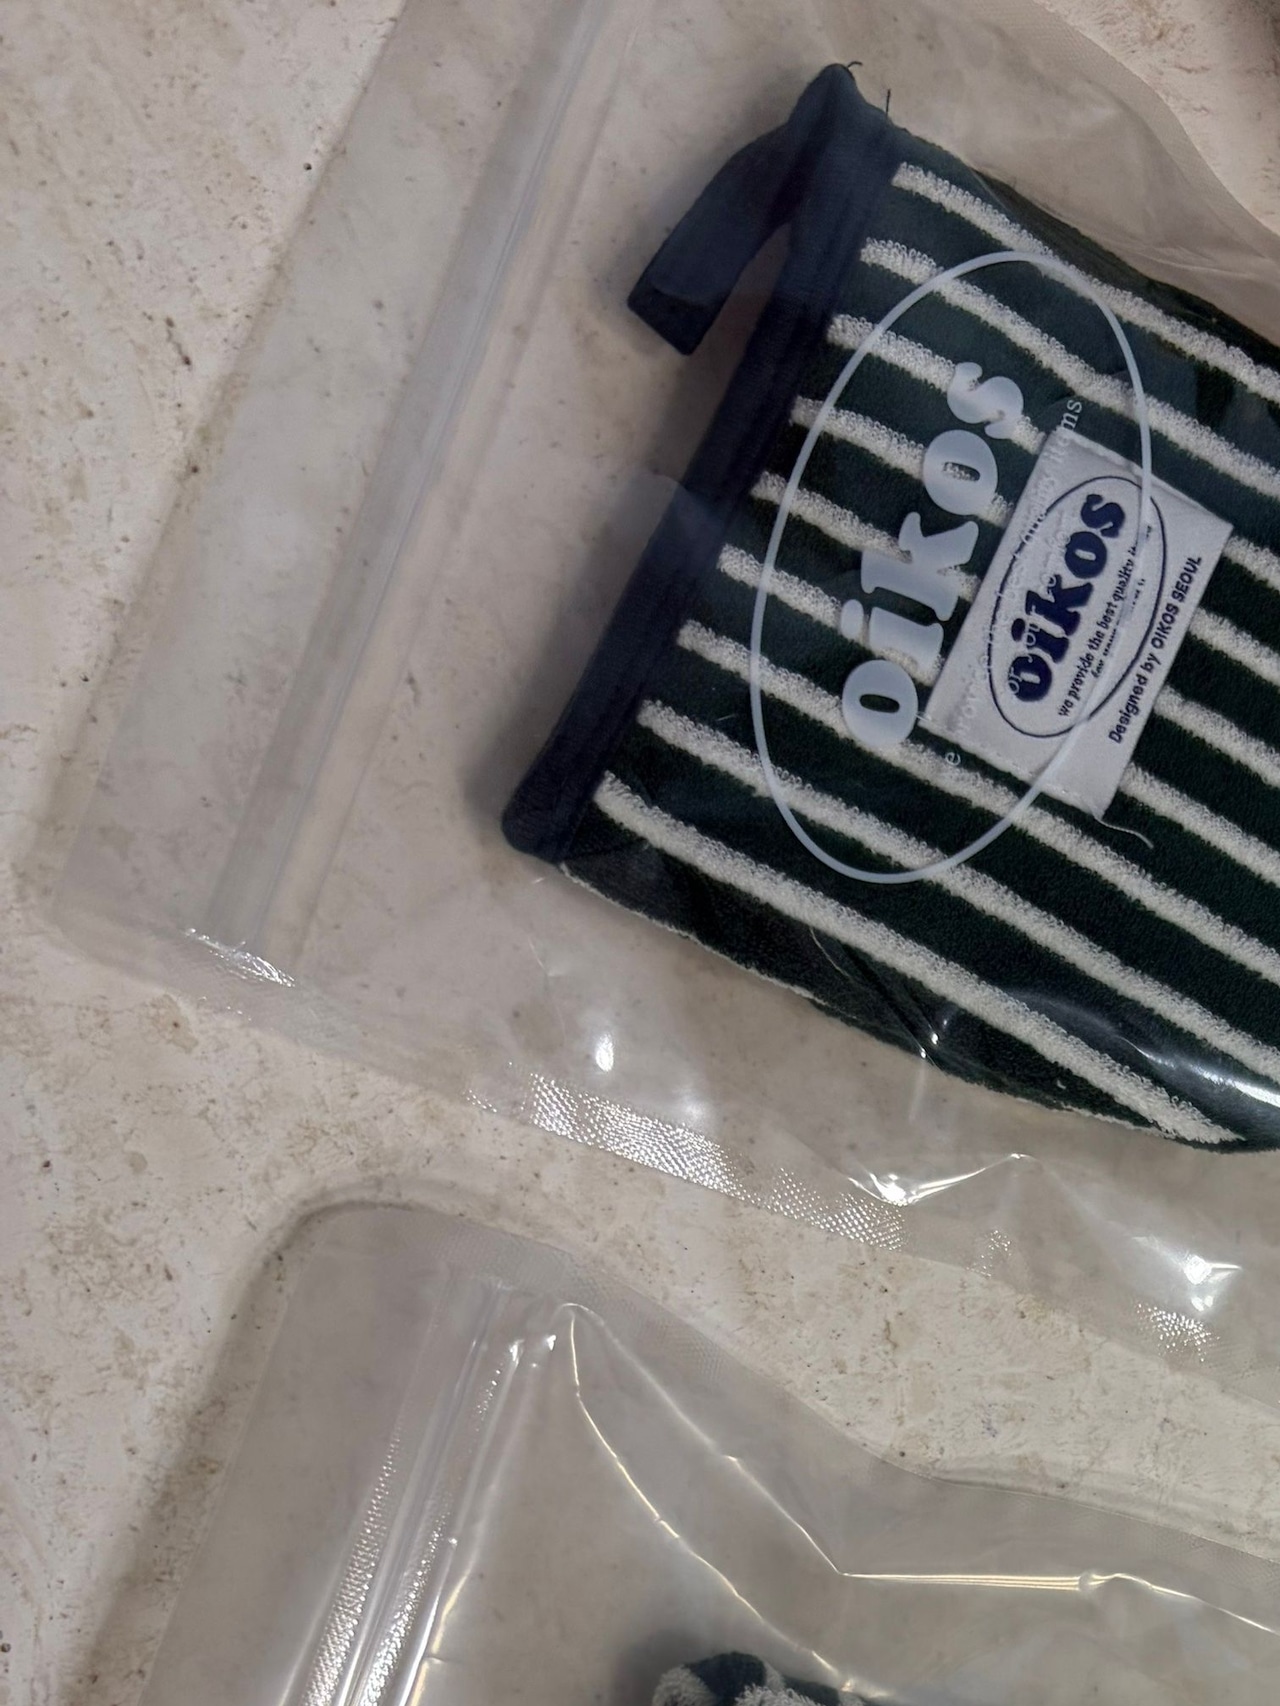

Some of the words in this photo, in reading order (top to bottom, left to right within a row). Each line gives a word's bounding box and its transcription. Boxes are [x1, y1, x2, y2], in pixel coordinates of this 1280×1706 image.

[840, 361, 1024, 749] oikos
[1169, 552, 1203, 603] SEOUL
[1008, 494, 1126, 702] oikos
[1067, 651, 1095, 700] provide
[1085, 629, 1105, 652] the
[1096, 600, 1119, 630] best
[1111, 559, 1139, 603] quality
[1148, 602, 1181, 651] OIKOS
[1138, 652, 1162, 673] by
[1107, 673, 1149, 744] Designed
